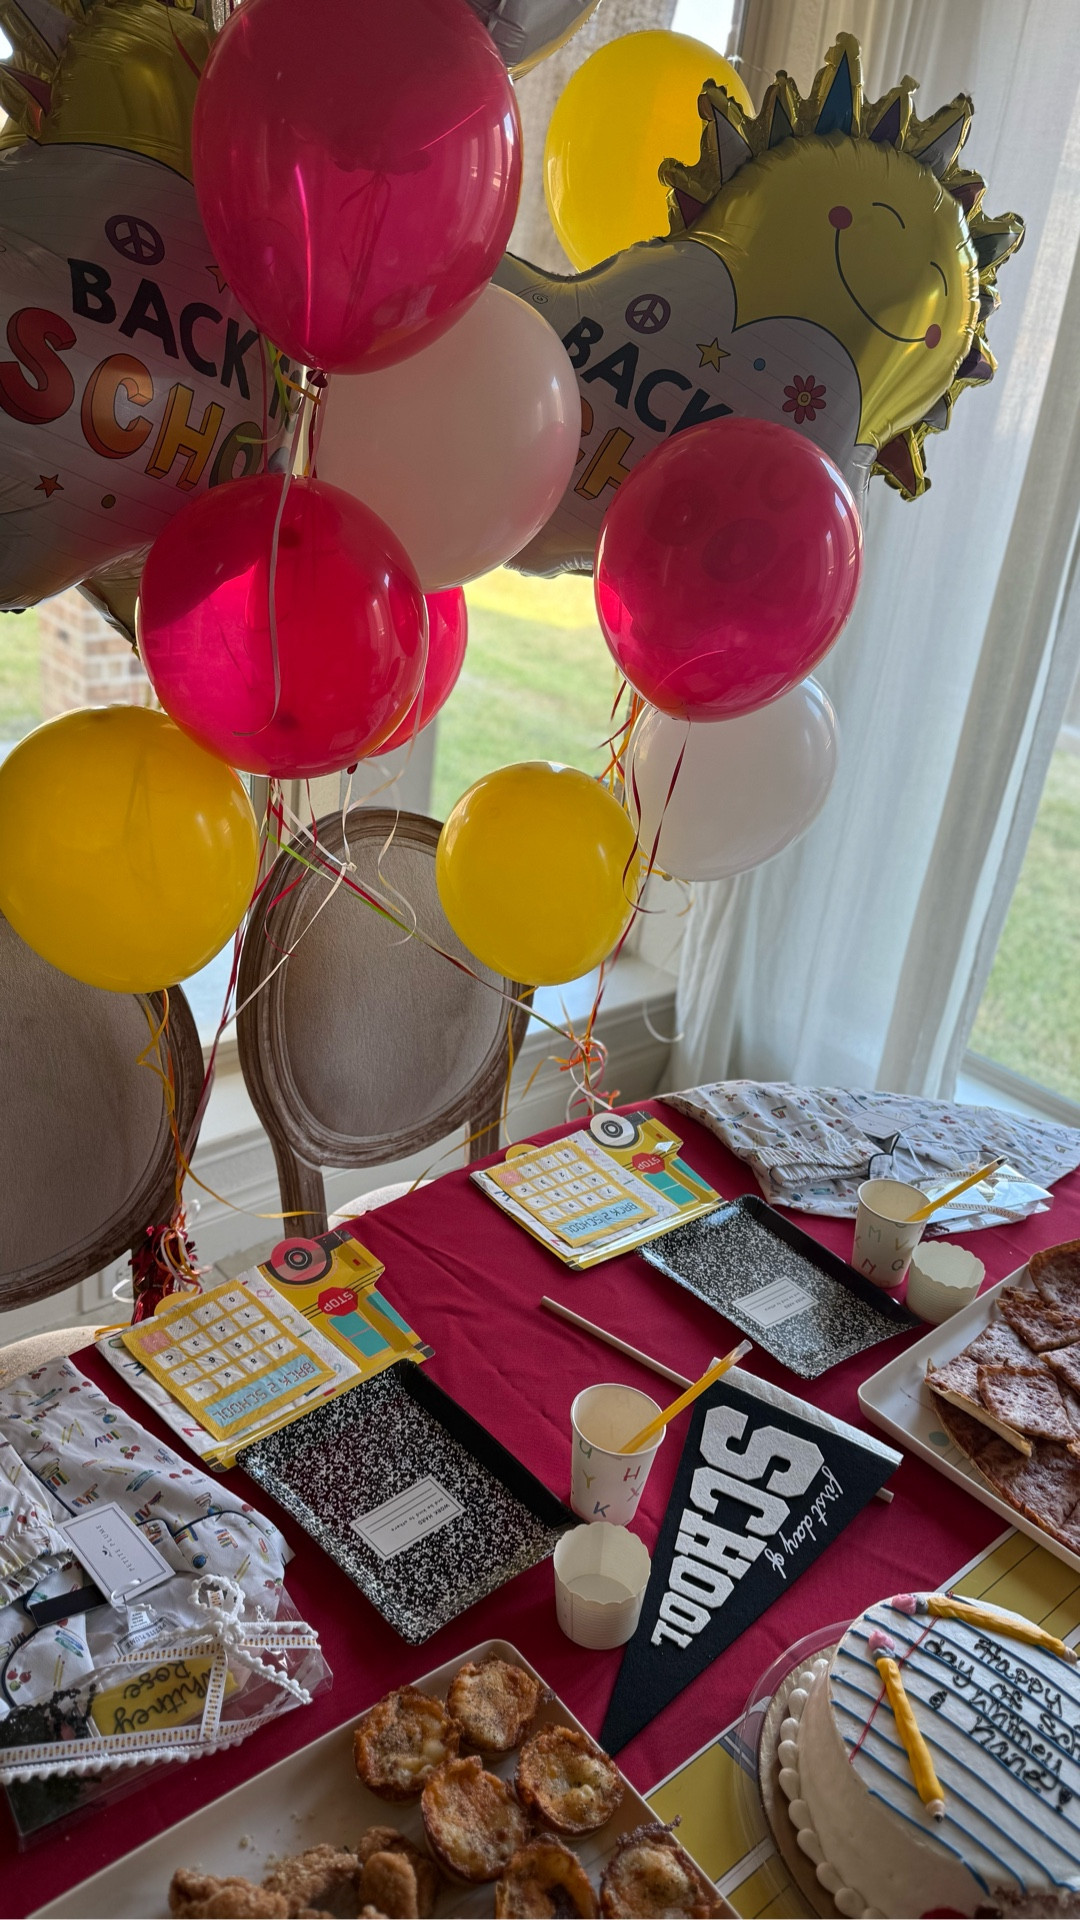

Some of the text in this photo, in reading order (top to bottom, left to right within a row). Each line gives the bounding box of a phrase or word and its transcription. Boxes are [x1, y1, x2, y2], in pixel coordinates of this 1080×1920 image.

[67, 257, 259, 400] BACK
[638, 1156, 660, 1170] STOP
[563, 1202, 637, 1234] BACK 2 SCHOOL
[324, 1290, 354, 1312] STOP
[212, 1363, 315, 1420] BACK 2 SCHOOL
[417, 1514, 434, 1525] HARD
[593, 1501, 610, 1518] K
[650, 1405, 825, 1649] SCHOOL
[765, 1465, 844, 1580] first day of
[96, 1525, 135, 1572] PETITE PLUME
[124, 1659, 191, 1699] Rose
[924, 1638, 973, 1688] day
[974, 1637, 1062, 1718] Happy
[970, 1688, 1063, 1788] Whitney
